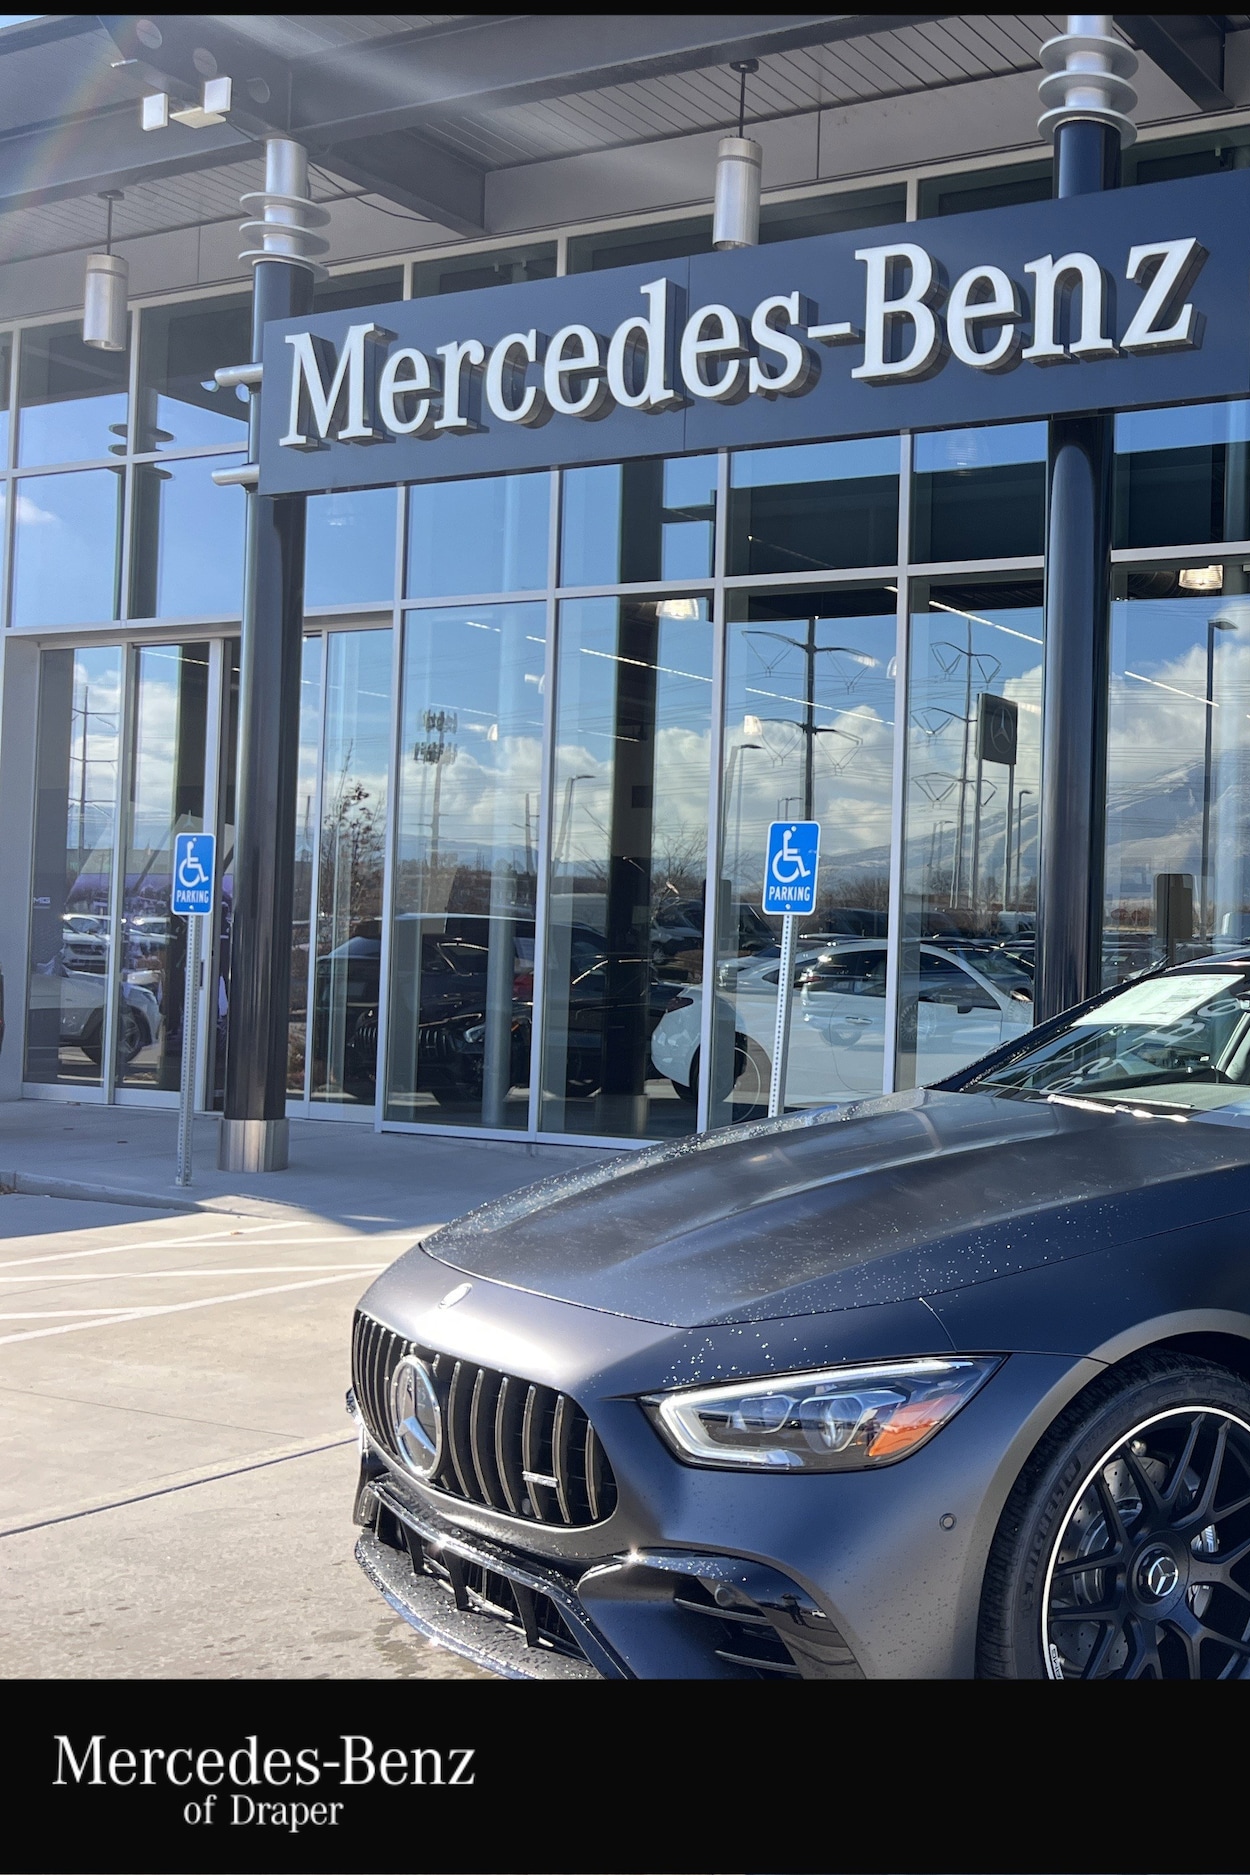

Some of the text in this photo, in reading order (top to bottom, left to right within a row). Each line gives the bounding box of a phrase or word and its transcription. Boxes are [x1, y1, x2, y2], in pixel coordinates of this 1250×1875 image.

[279, 237, 1198, 448] Mercedes-Benz
[176, 889, 209, 904] PARKING
[769, 886, 811, 901] PARKING
